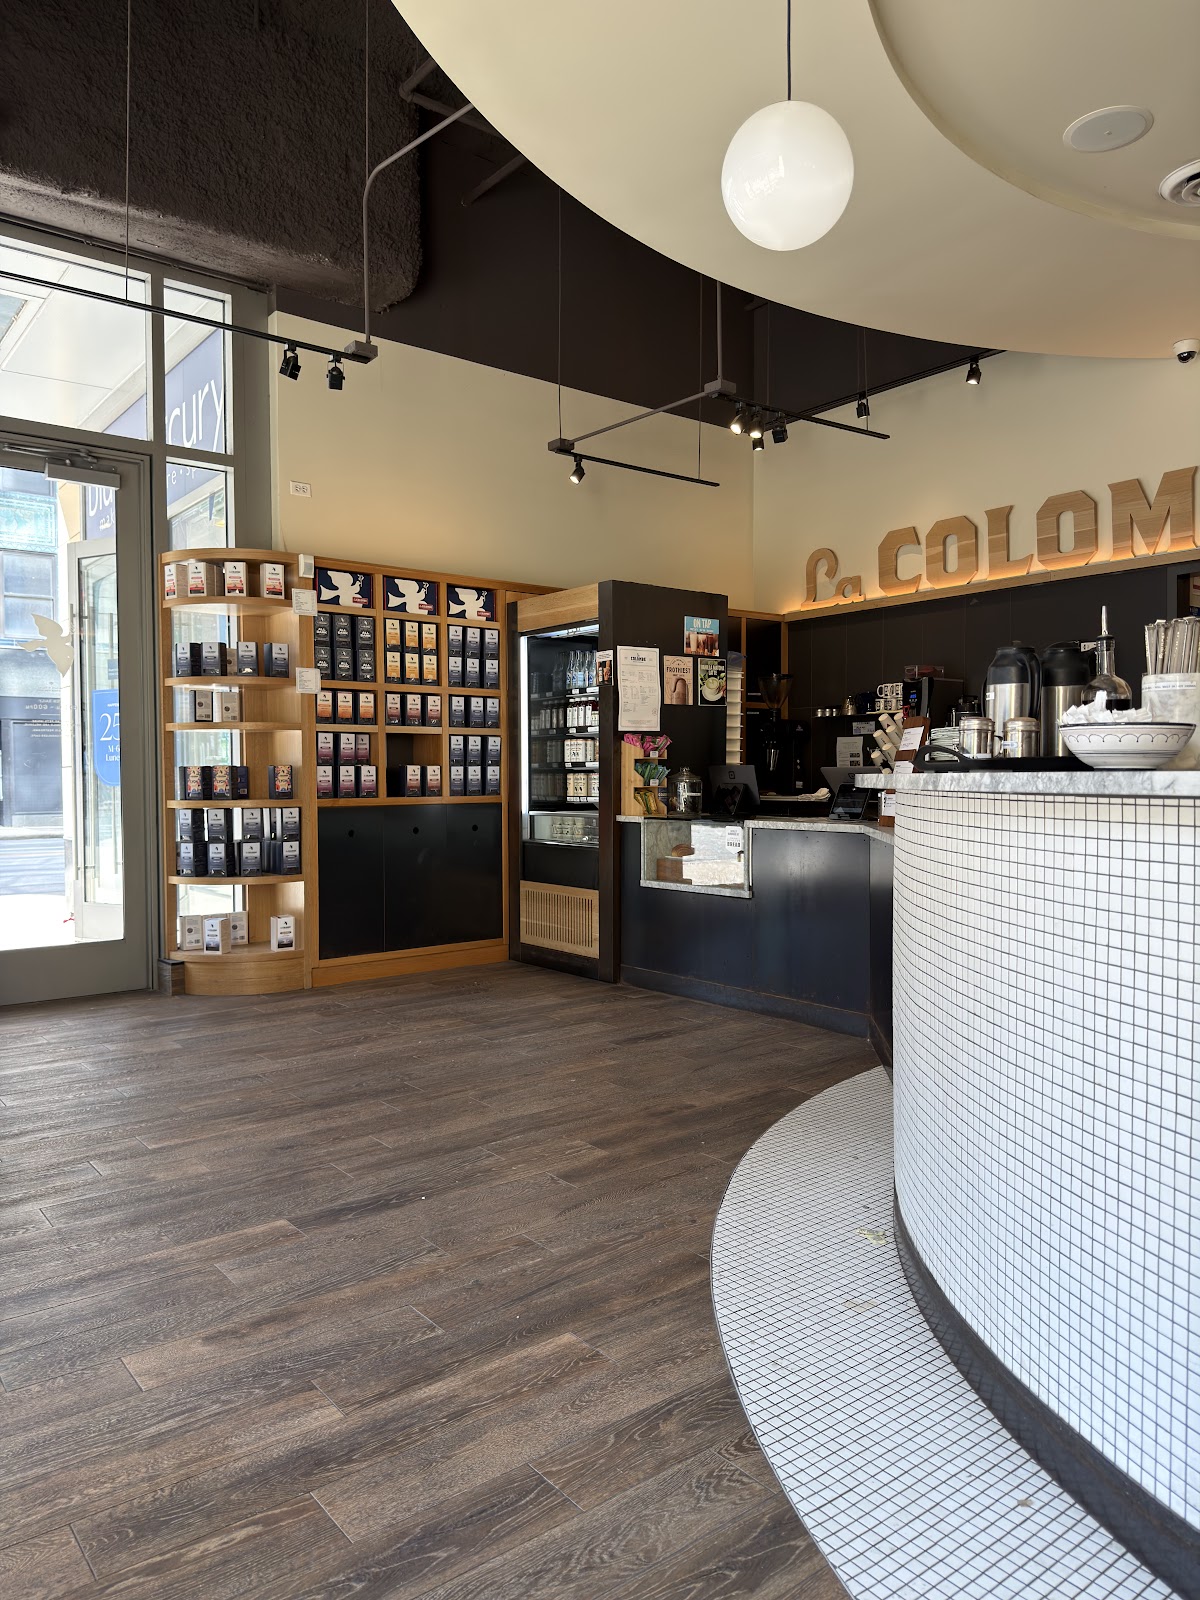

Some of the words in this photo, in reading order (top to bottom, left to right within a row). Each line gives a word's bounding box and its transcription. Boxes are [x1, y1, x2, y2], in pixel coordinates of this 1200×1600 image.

[165, 379, 223, 452] cury
[801, 547, 866, 611] La
[878, 465, 1200, 597] COLOM
